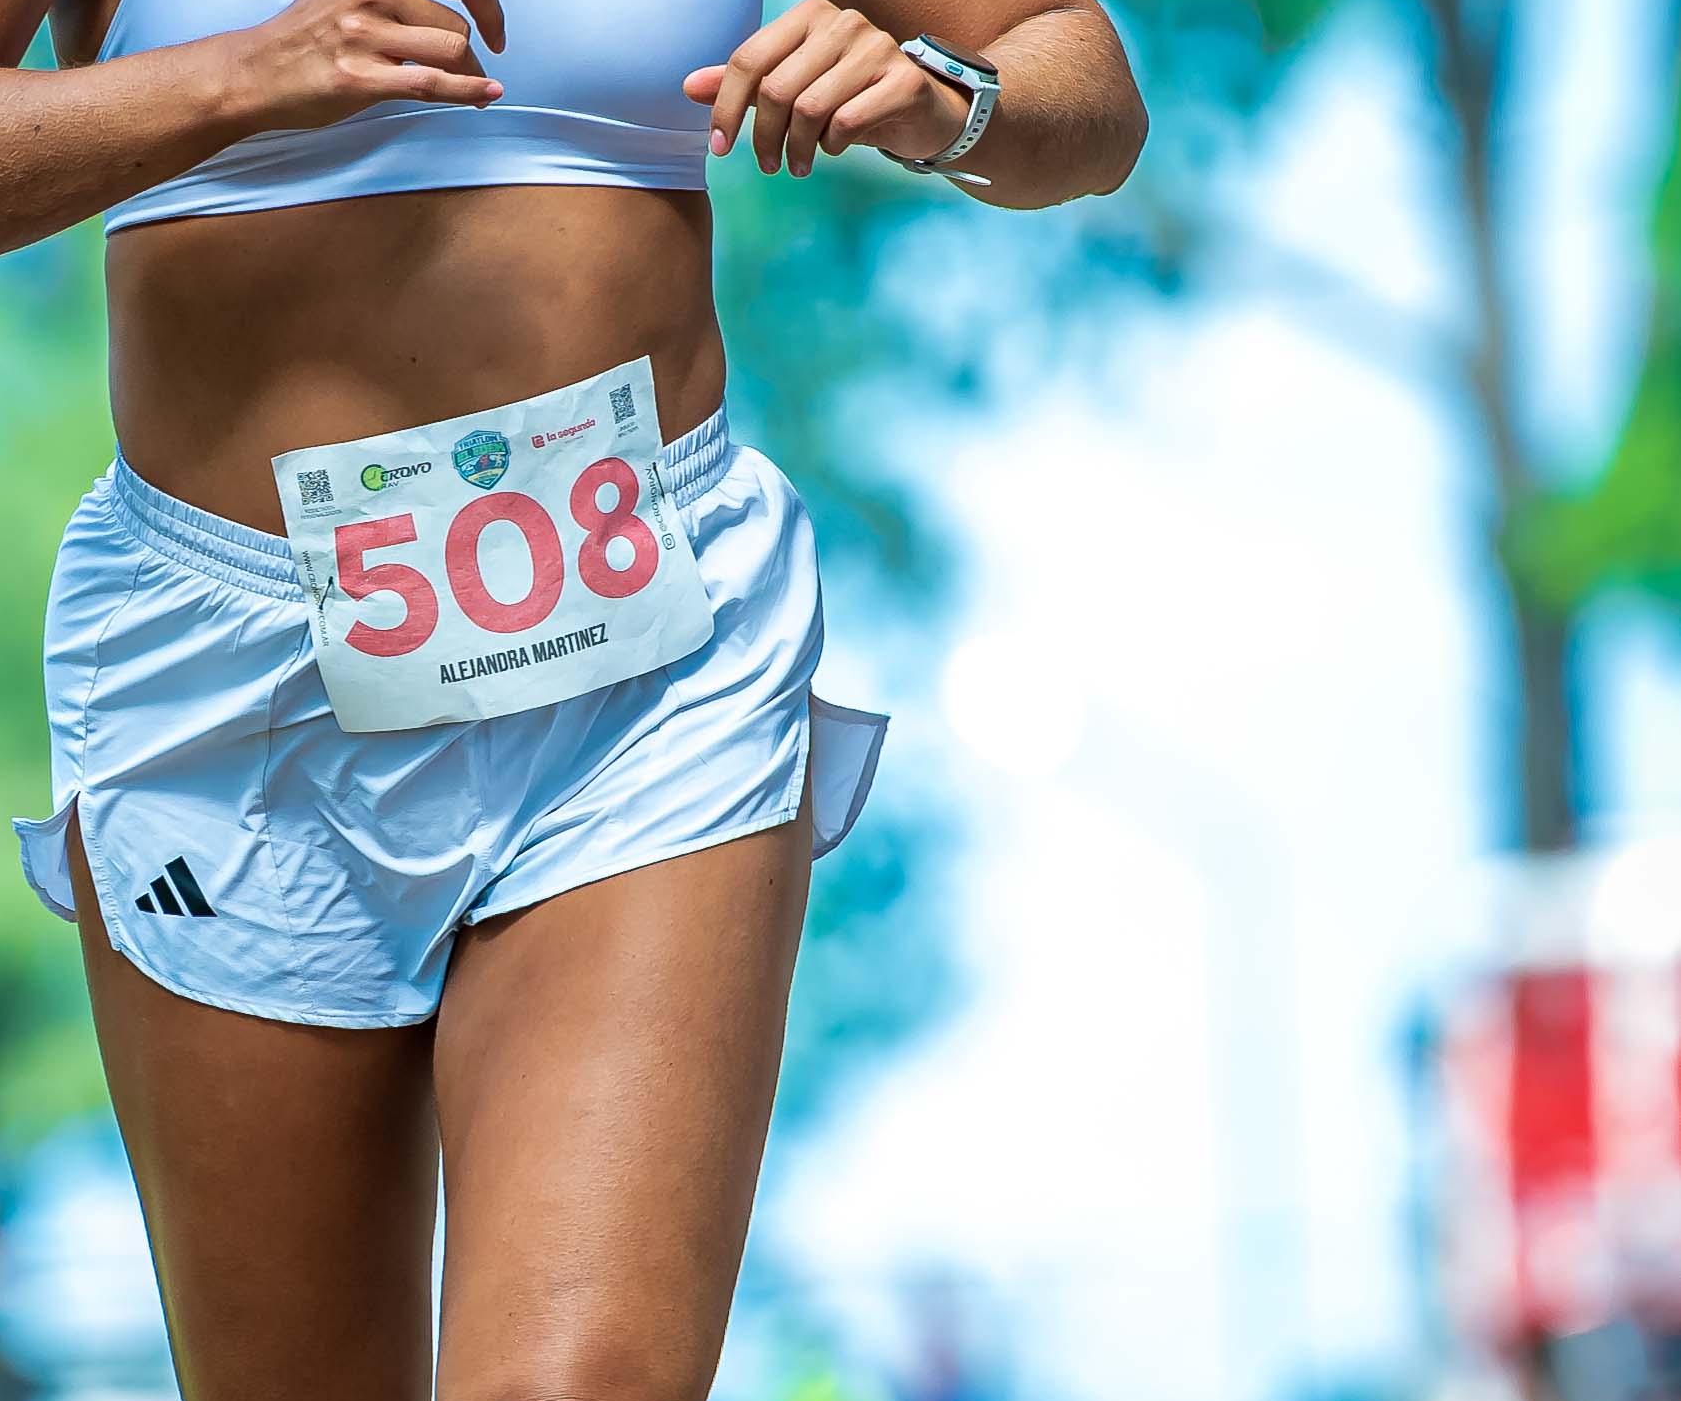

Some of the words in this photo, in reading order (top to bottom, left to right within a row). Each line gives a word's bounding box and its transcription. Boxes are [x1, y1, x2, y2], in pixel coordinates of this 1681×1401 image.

[546, 432, 557, 442] la
[557, 419, 596, 437] segunda
[380, 462, 432, 482] CRONO
[335, 457, 659, 657] 508
[440, 647, 531, 684] ALEJANDRA
[531, 622, 609, 664] MARTINEZ
